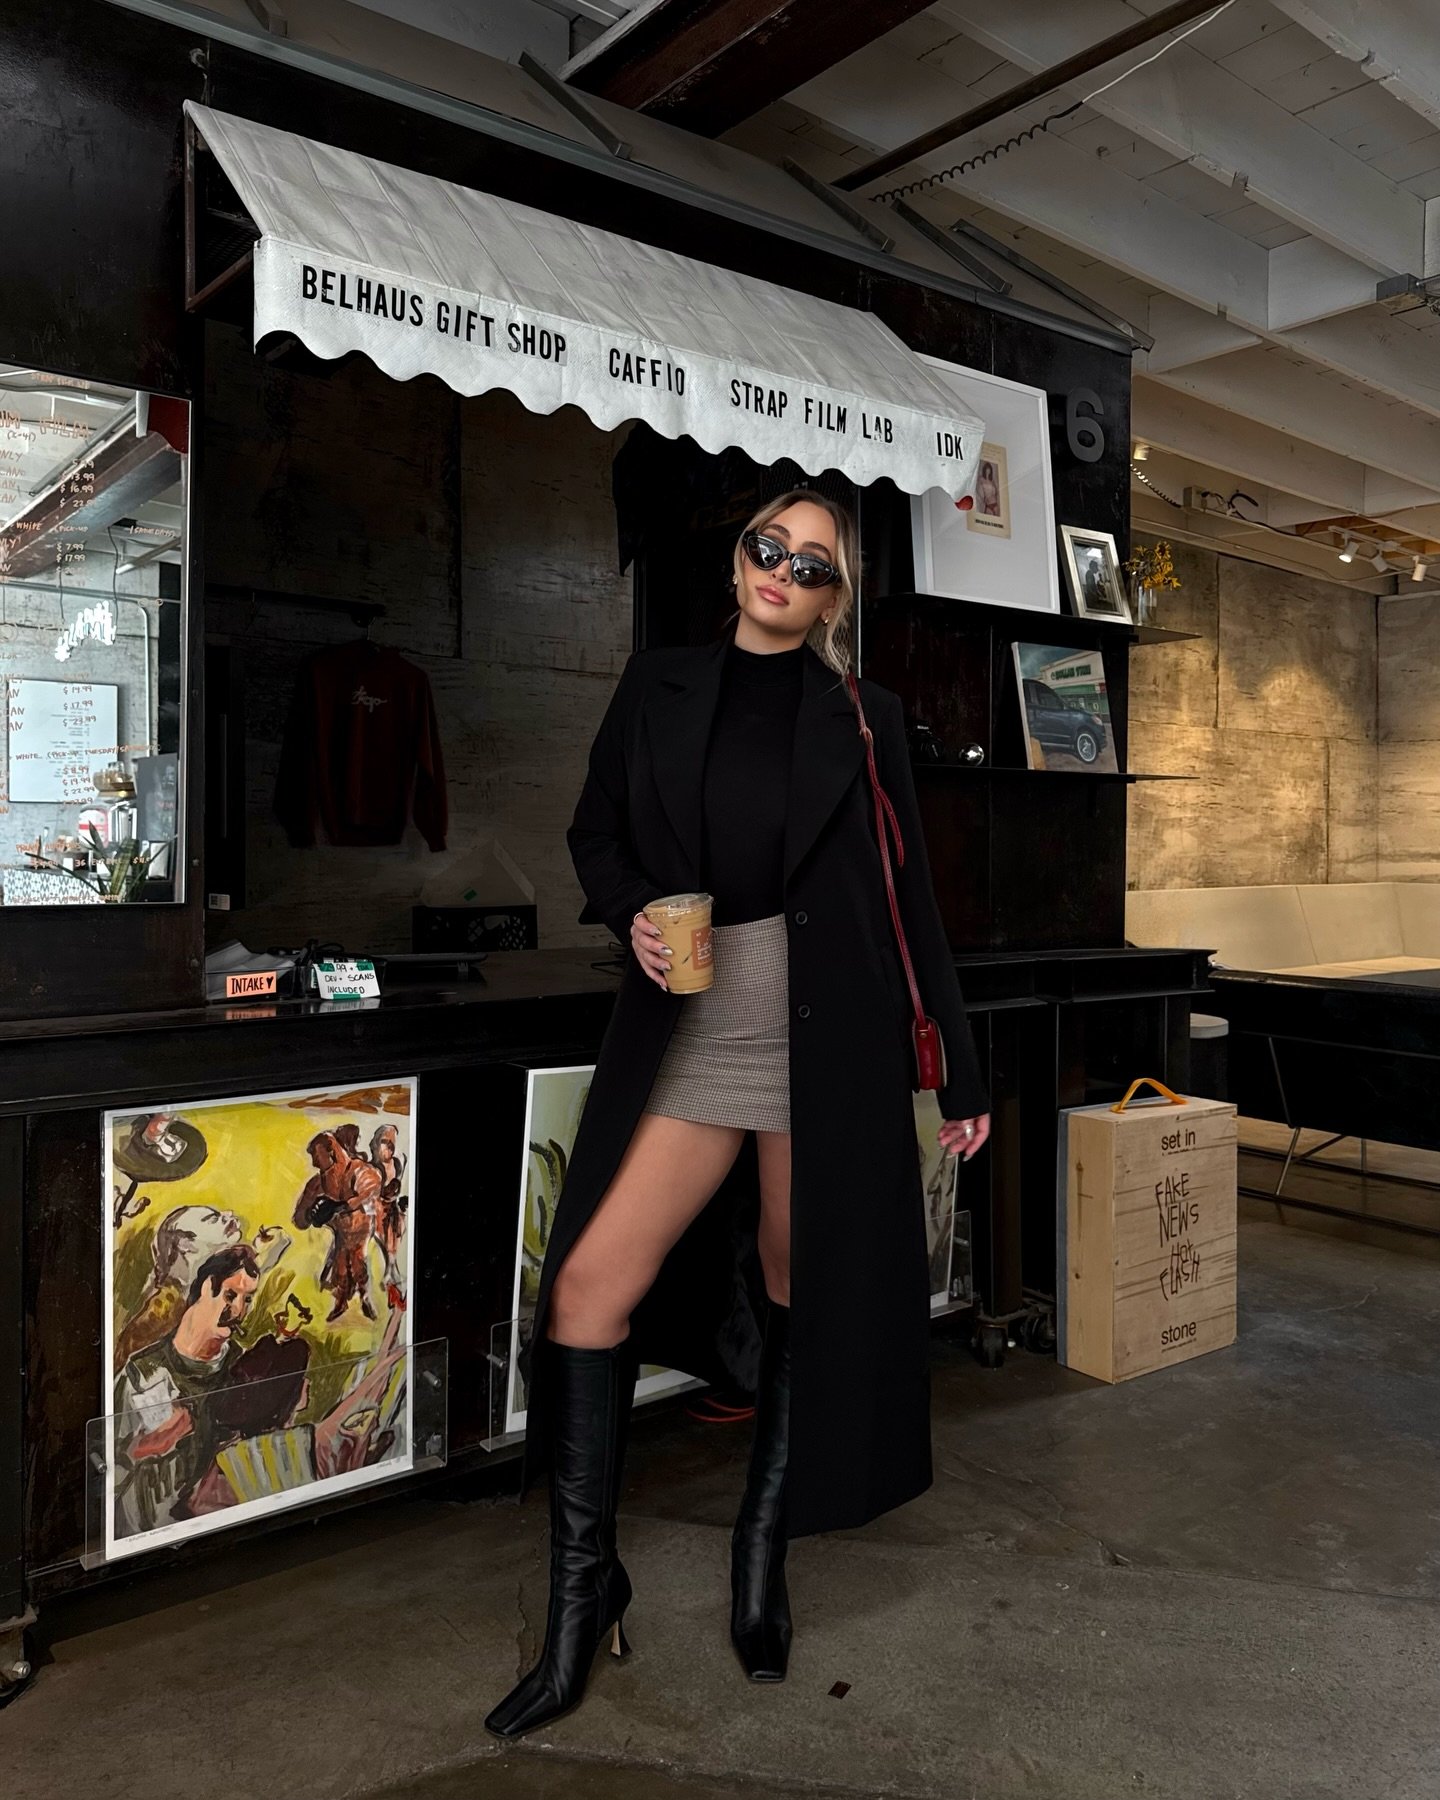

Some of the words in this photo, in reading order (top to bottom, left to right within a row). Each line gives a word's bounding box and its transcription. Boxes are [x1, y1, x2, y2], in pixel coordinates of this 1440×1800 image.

[302, 264, 424, 327] BELHAUS
[437, 301, 494, 347] GIFT
[507, 322, 566, 363] SHOP
[608, 347, 685, 396] CAFFIO
[730, 379, 788, 418] STRAP
[804, 397, 847, 434] FILM
[862, 412, 893, 444] LAB
[936, 431, 964, 461] IDK
[1066, 387, 1105, 463] 6
[231, 976, 264, 995] INTAKE
[325, 974, 337, 982] DEV
[347, 973, 375, 982] SCANS
[327, 985, 365, 994] INCLUDED
[1161, 1130, 1181, 1151] set
[1185, 1128, 1196, 1146] in
[1155, 1172, 1190, 1208] FAKE
[1159, 1203, 1199, 1248] NEWS
[1159, 1251, 1200, 1301] FLASH
[1161, 1321, 1197, 1345] stone
